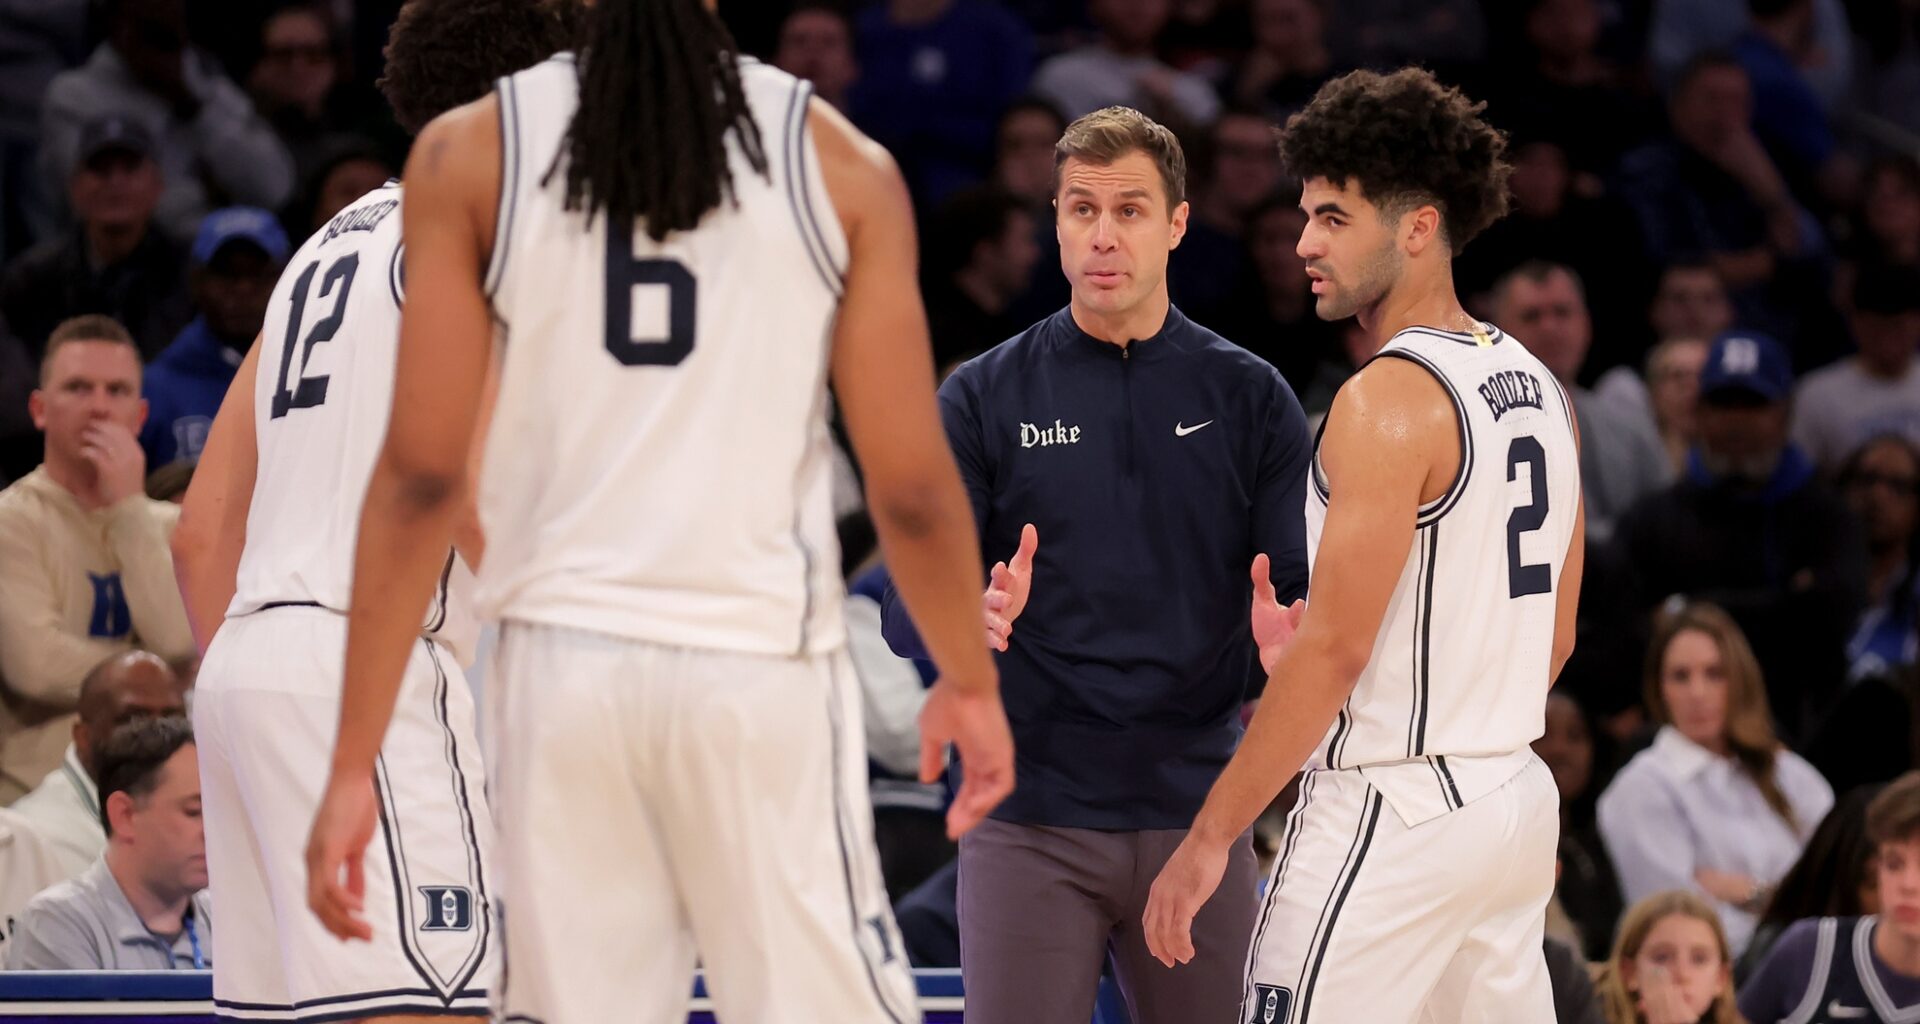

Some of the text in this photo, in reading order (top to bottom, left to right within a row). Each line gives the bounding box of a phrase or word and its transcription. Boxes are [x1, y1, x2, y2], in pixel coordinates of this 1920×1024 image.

[270, 250, 360, 420] 12
[606, 205, 697, 366] 6
[1020, 418, 1081, 448] Duke
[1507, 435, 1552, 599] 2
